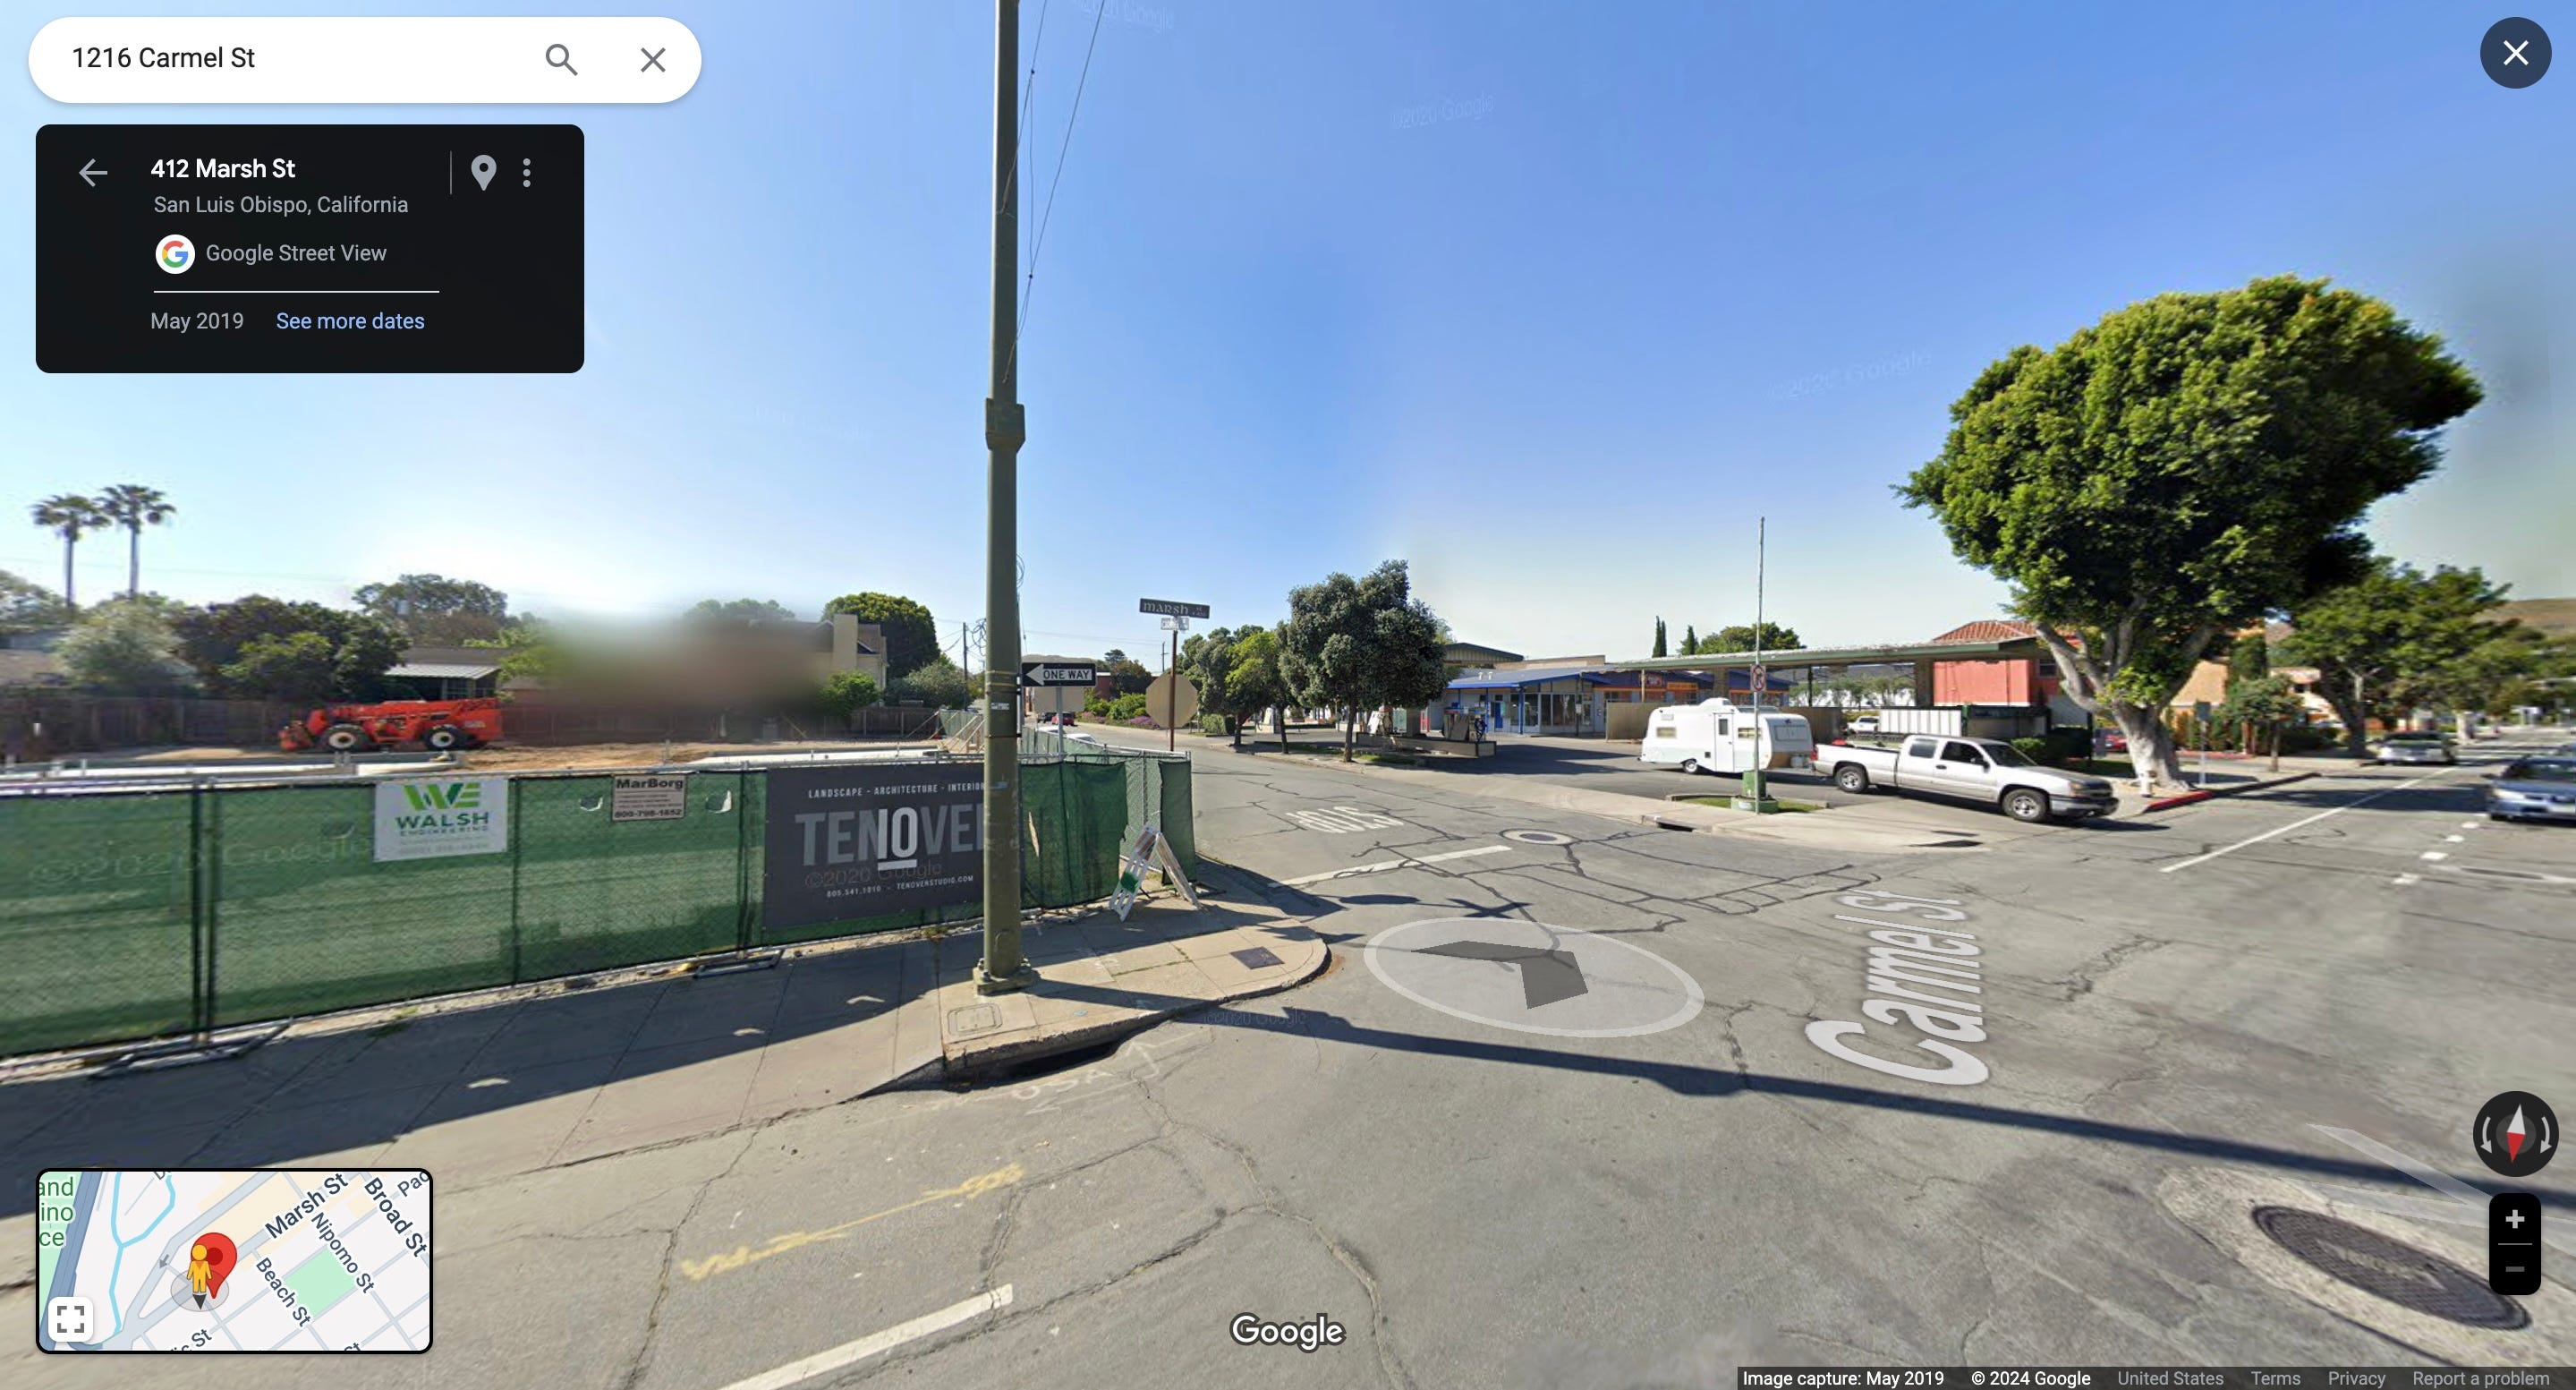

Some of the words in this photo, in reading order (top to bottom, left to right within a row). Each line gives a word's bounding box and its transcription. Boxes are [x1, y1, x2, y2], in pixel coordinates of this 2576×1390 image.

[1042, 669, 1066, 680] ONE
[1067, 669, 1091, 680] WAY
[616, 778, 684, 790] MarBorg
[808, 787, 863, 799] LANDSCAPE
[873, 783, 939, 796] ARCHITECTURE
[395, 812, 489, 829] WALSH
[897, 875, 973, 891] TENOVERSTUDIO.COM
